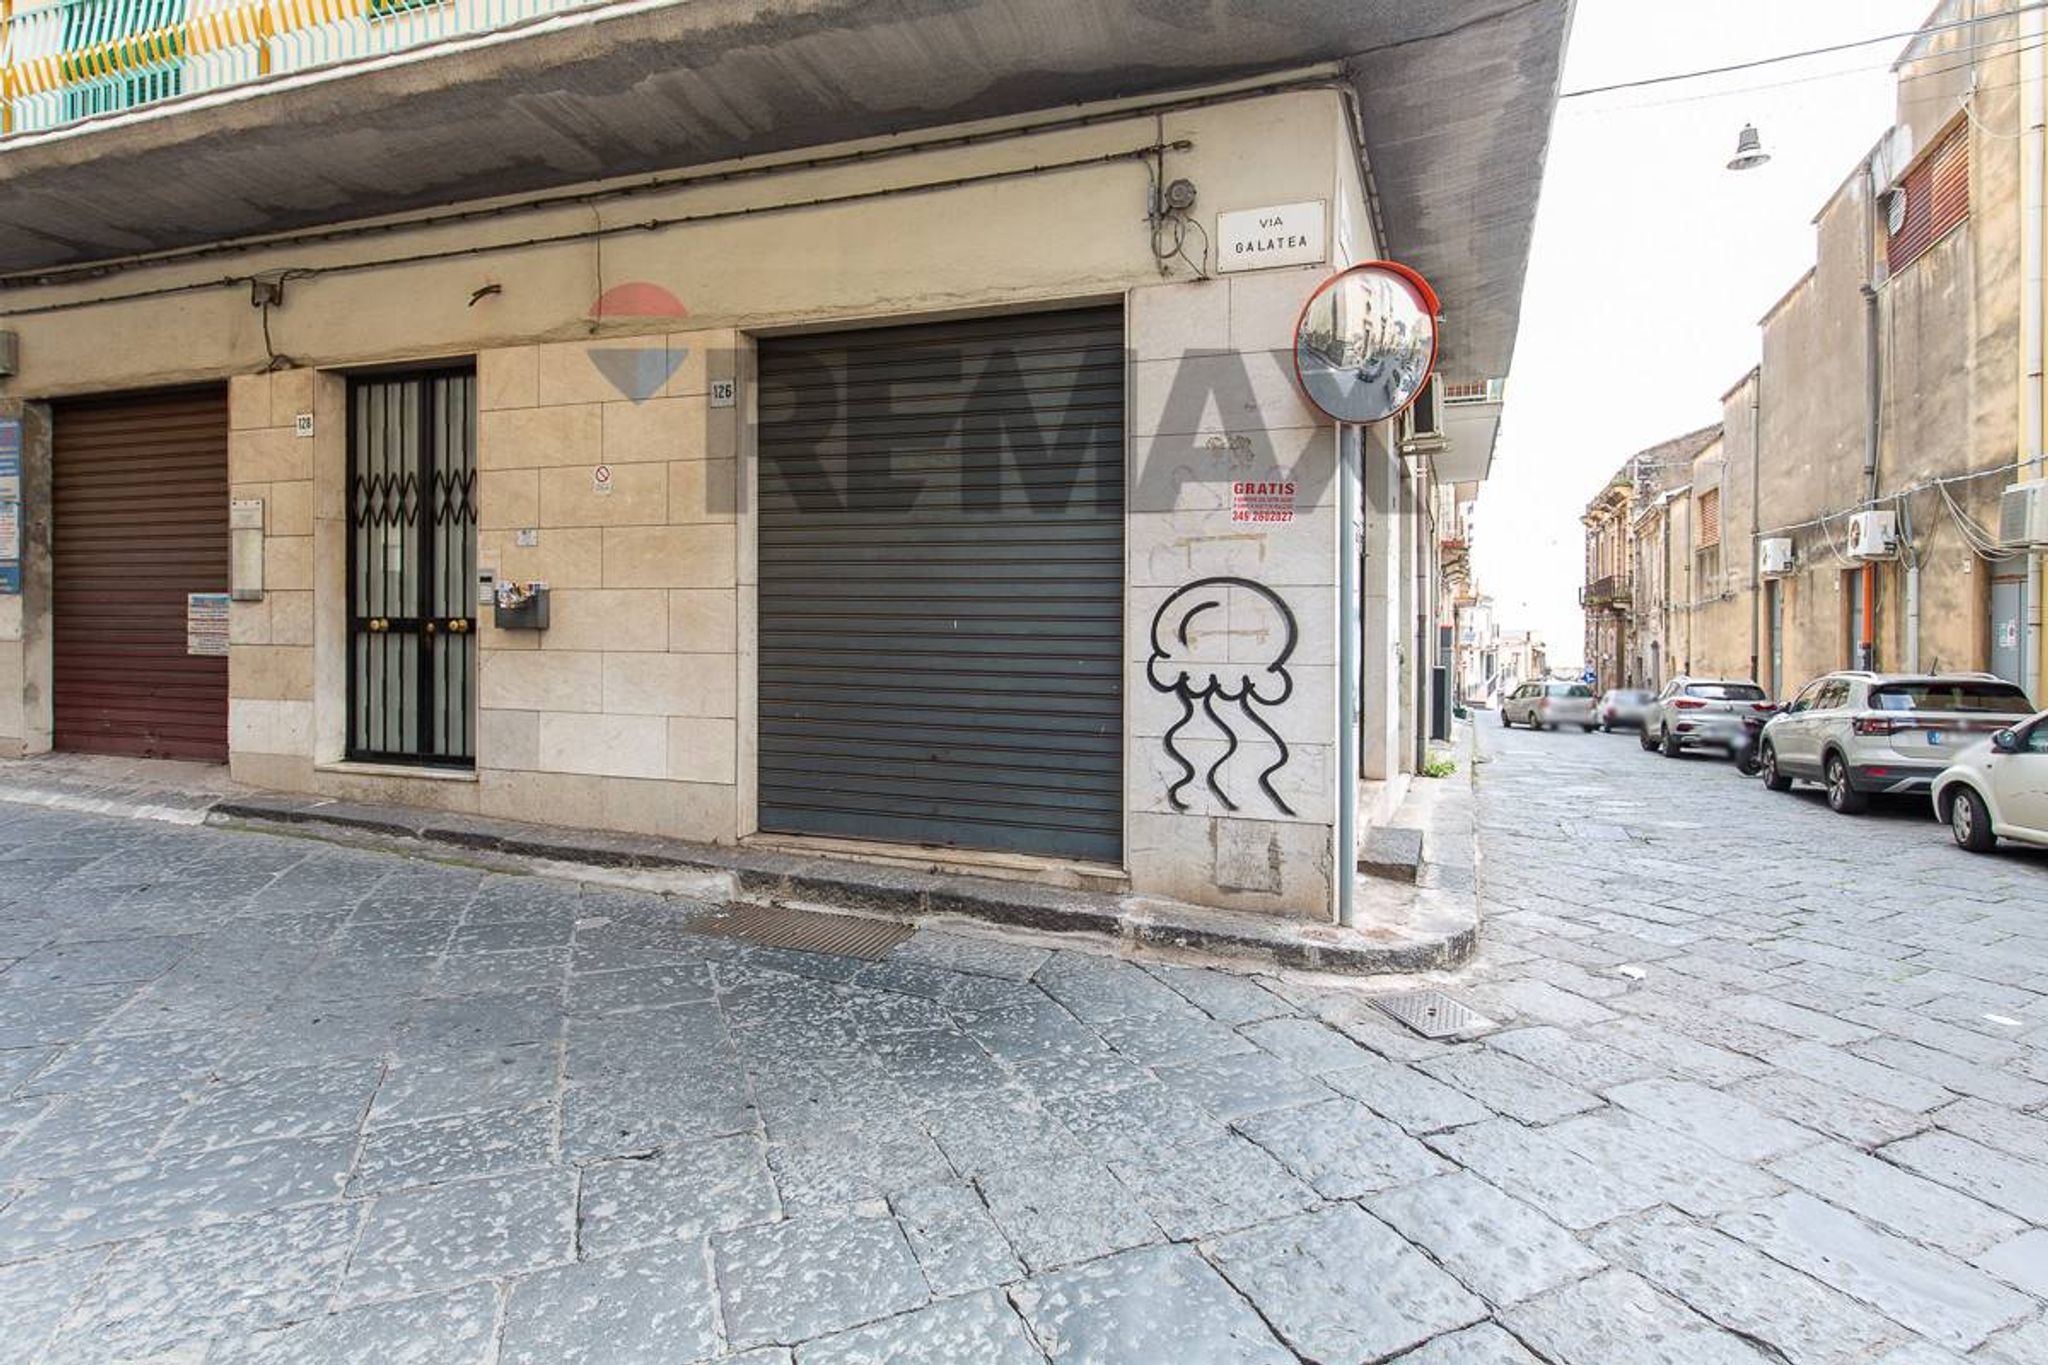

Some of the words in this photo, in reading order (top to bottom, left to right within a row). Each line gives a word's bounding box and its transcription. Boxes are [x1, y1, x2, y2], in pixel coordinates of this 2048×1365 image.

[1259, 216, 1283, 229] VIA
[1235, 235, 1307, 254] GALATEA
[713, 383, 732, 399] 126
[1233, 482, 1295, 495] GRATIS
